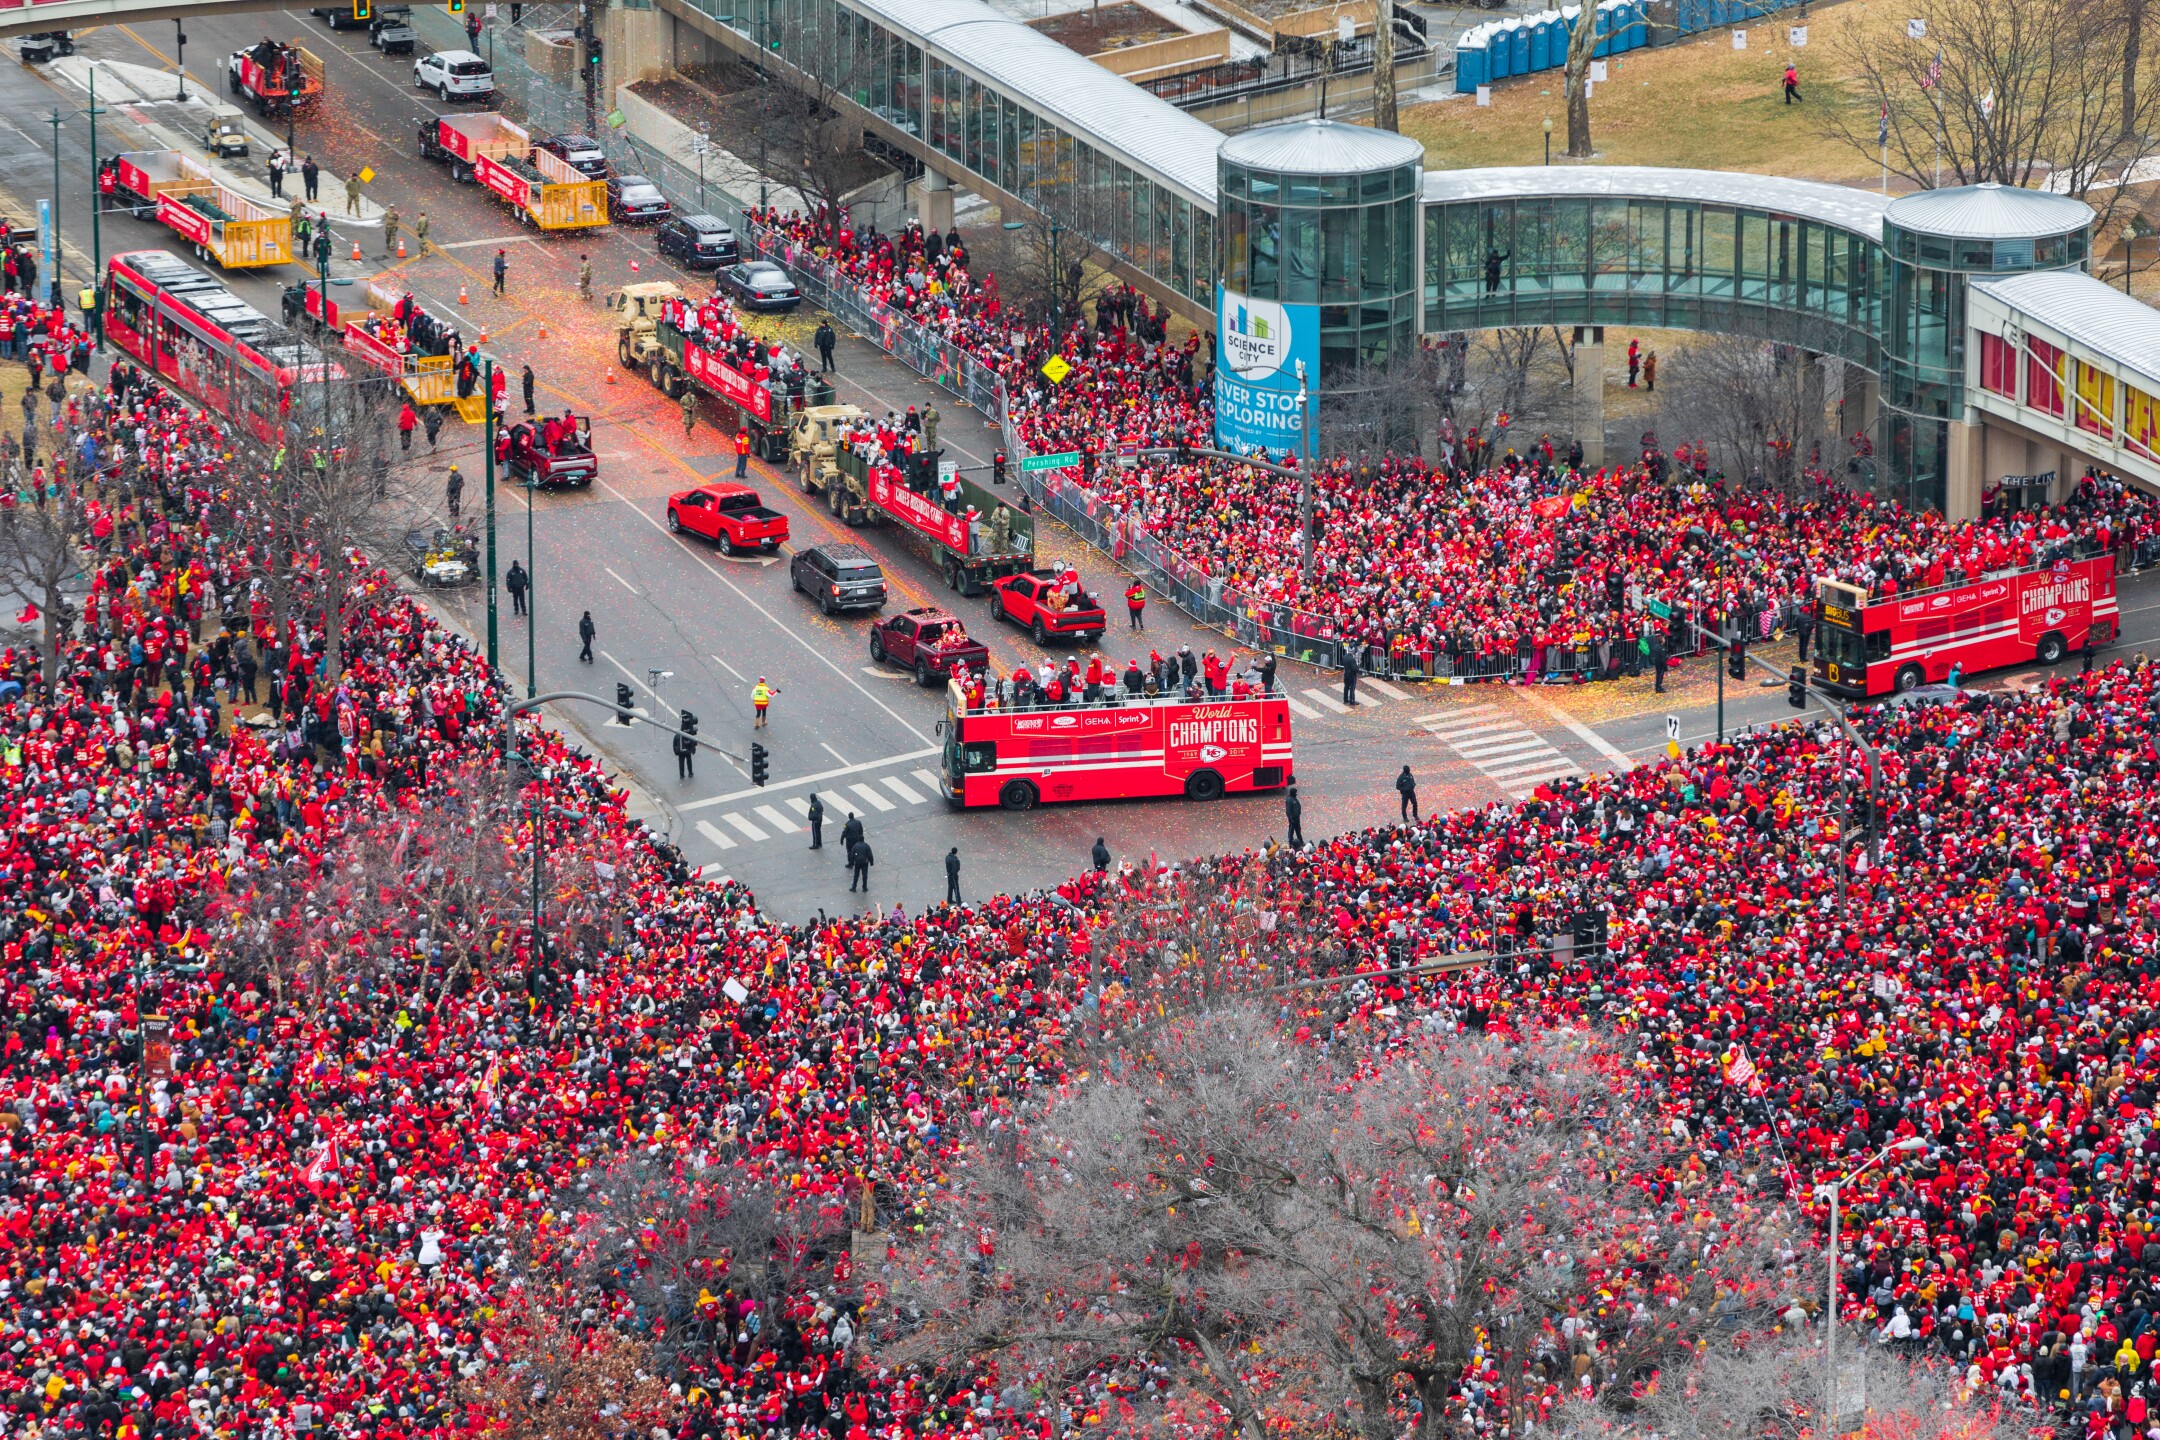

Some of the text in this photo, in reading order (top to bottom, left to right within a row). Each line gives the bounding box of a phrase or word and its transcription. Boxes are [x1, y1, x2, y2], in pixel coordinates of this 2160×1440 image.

[1228, 335, 1275, 355] SCIENCE
[1239, 351, 1260, 362] CITY
[707, 357, 749, 395] CHIEFS BUSINESS STAFF
[1234, 424, 1254, 434] POWERED
[1027, 458, 1060, 468] Pershing
[2004, 476, 2029, 486] THE
[895, 486, 943, 527] CHIEFS BUSINESS STAFF
[1956, 592, 1977, 603] GEHA
[1982, 588, 1999, 598] Sprint
[2021, 577, 2090, 615] CHAMPIONS
[1322, 628, 1332, 637] 19
[1192, 705, 1232, 720] World
[1085, 717, 1111, 726] GEHA
[1118, 714, 1140, 725] Sprint
[1170, 718, 1257, 748] CHAMPIONS
[76, 752, 88, 761] 29
[2100, 888, 2110, 897] 15
[1475, 999, 1484, 1008] 15
[1843, 1240, 1853, 1249] 15
[1973, 1298, 1985, 1307] 15
